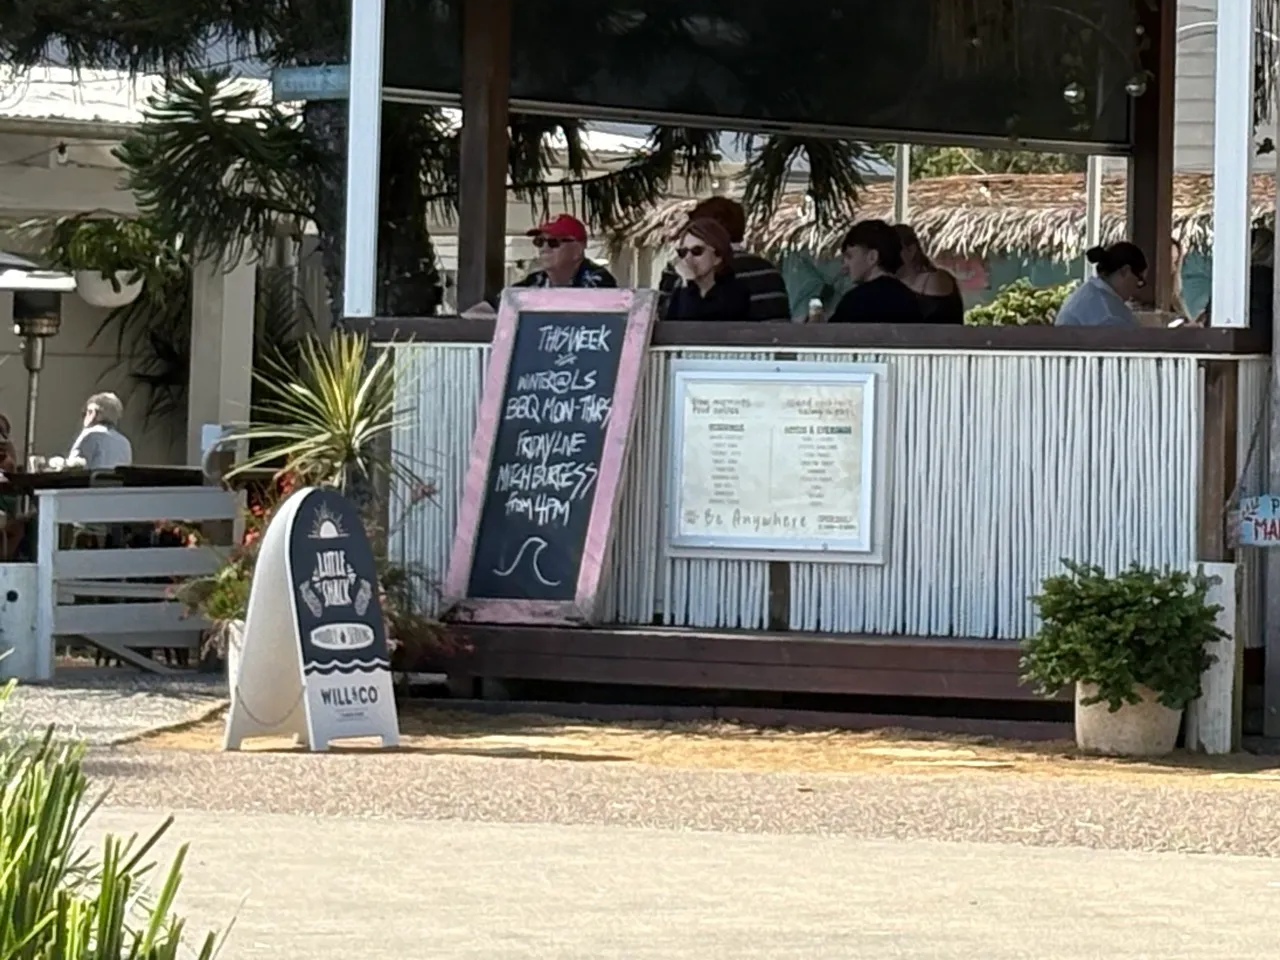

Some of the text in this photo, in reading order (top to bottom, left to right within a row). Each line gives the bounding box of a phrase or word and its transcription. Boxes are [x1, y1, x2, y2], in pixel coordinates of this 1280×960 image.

[538, 324, 612, 352] THIS WEEK
[505, 393, 541, 423] BBQ
[552, 430, 587, 457] LIVE
[534, 493, 571, 527] 4PM
[732, 508, 807, 532] Anywhere
[316, 550, 346, 577] LITTLE
[322, 579, 353, 608] SHACK
